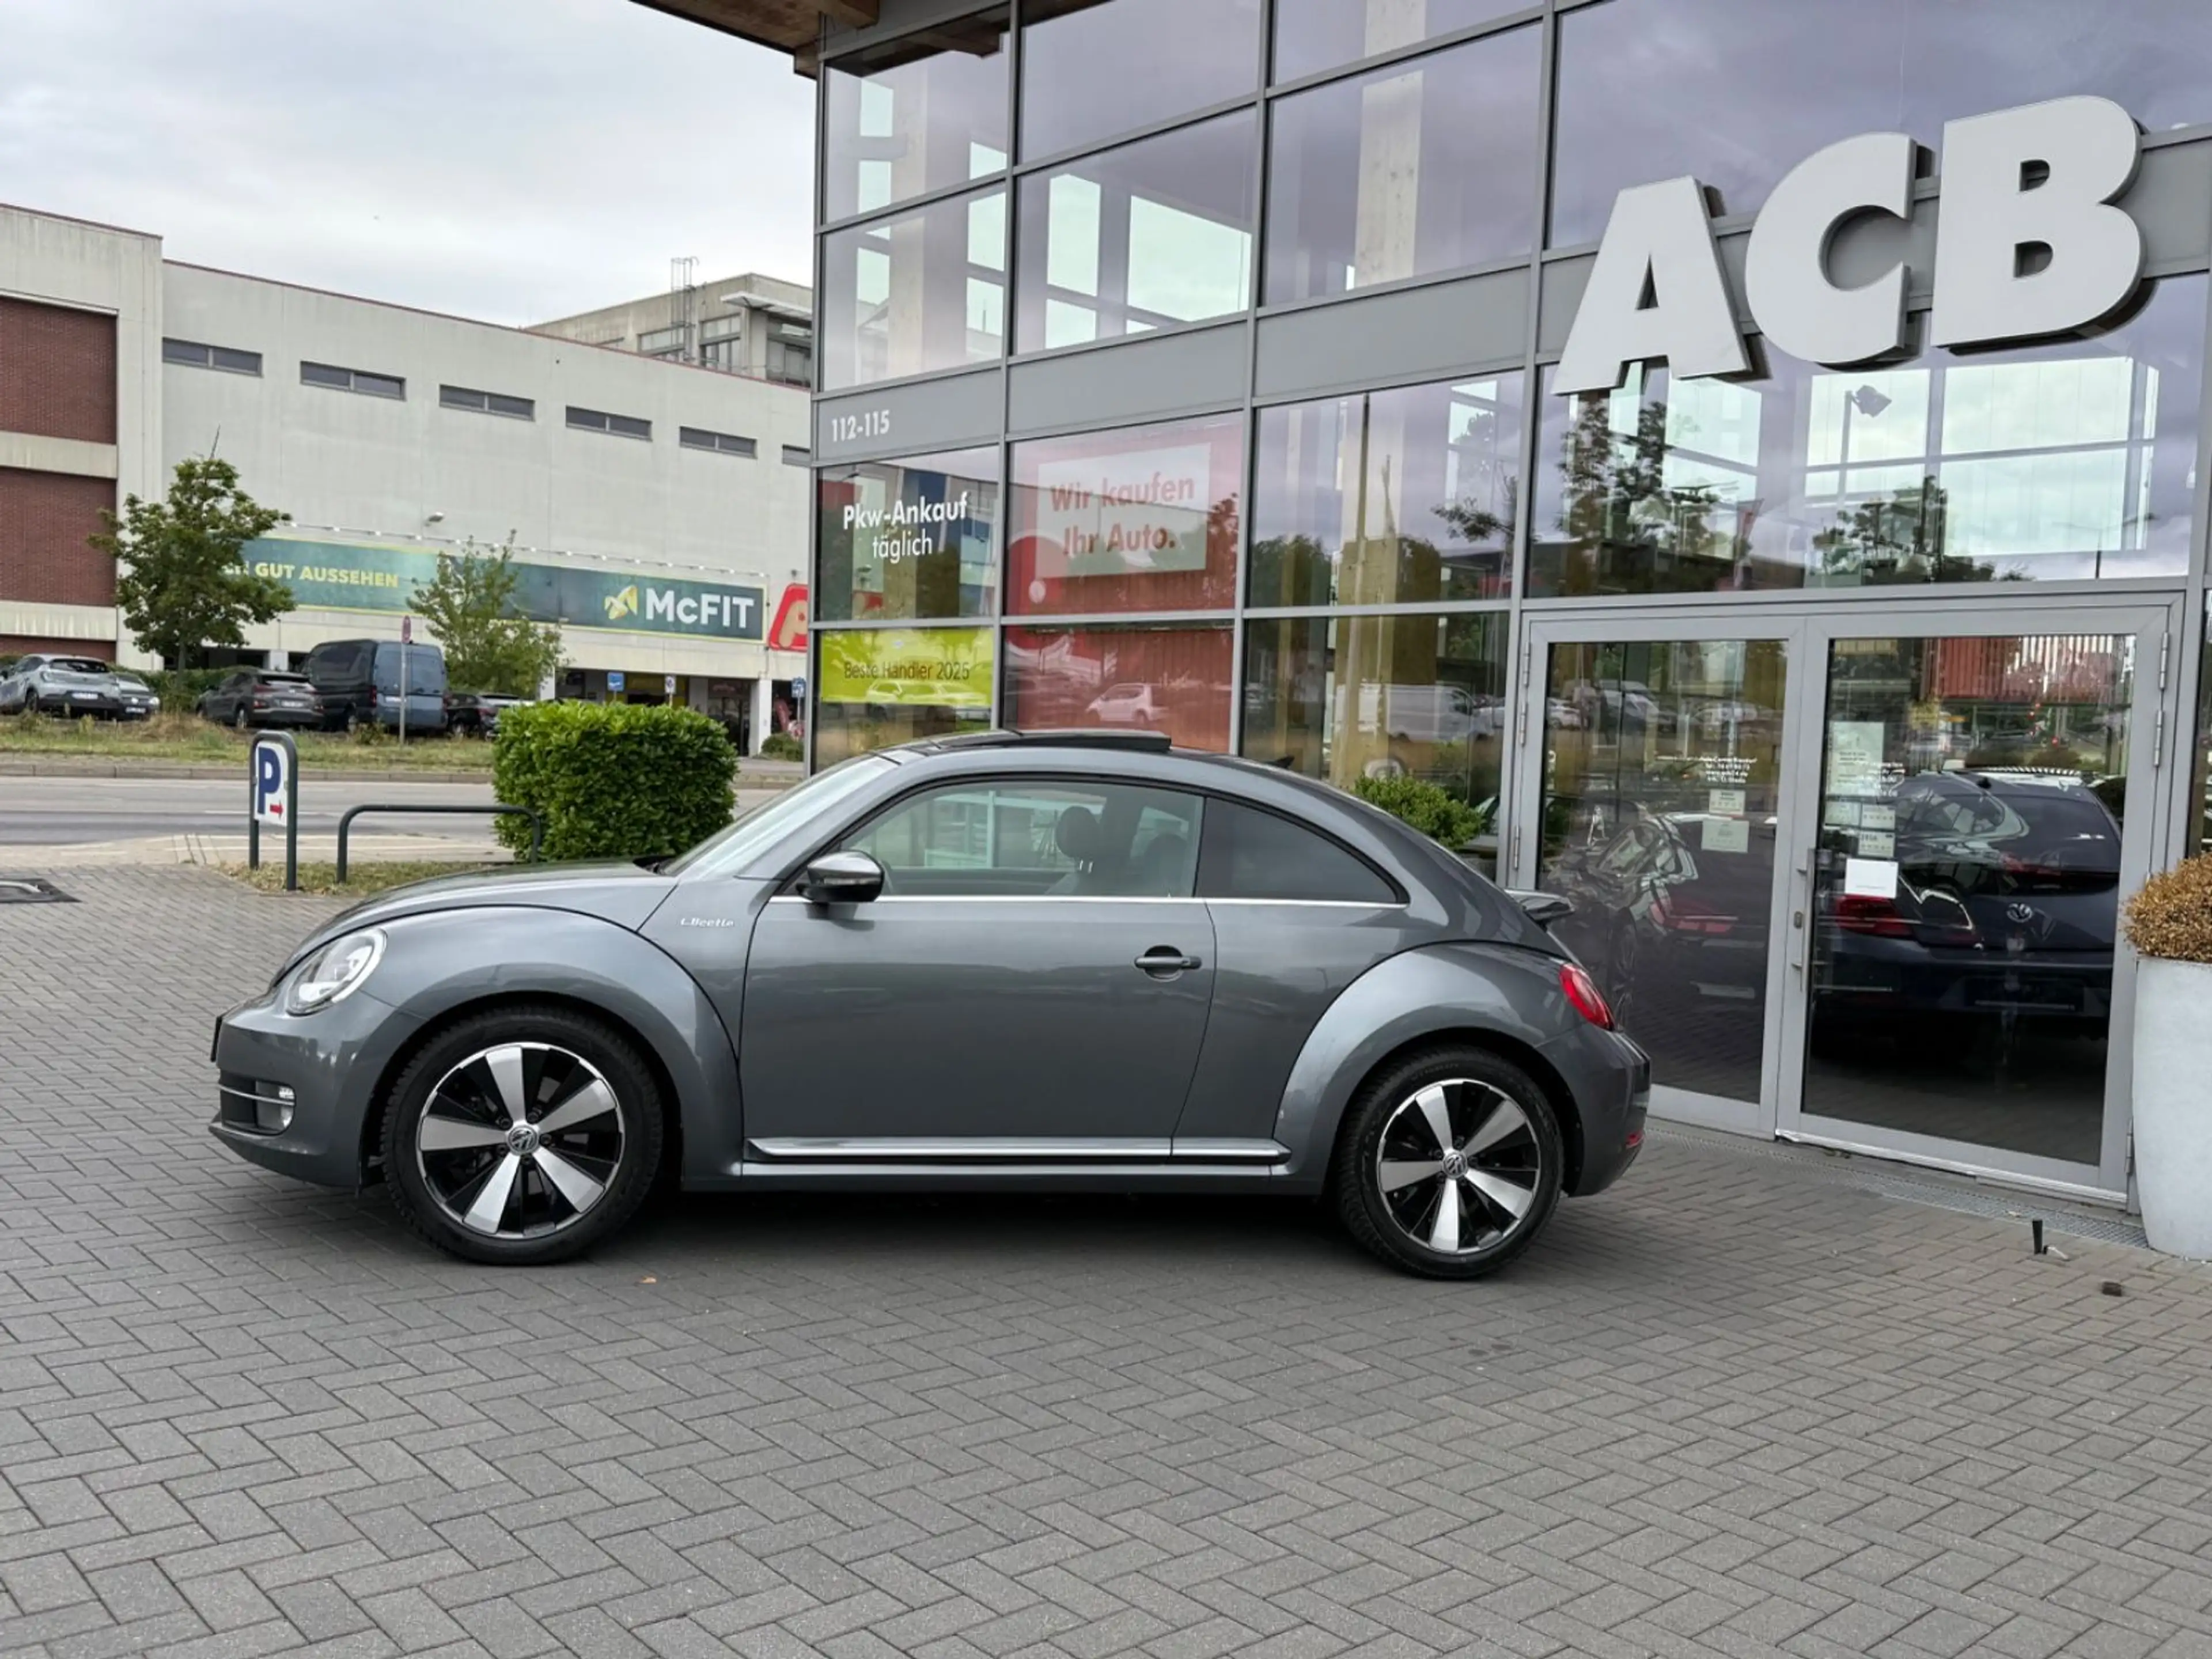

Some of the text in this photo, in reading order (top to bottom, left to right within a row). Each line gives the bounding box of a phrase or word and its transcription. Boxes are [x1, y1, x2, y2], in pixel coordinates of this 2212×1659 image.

[1551, 96, 2145, 396] ACB
[831, 409, 891, 442] 112-115
[1050, 471, 1195, 512] Wir kaufen
[843, 491, 968, 531] Pkw-Ankauf
[872, 528, 933, 564] täglich
[1063, 522, 1176, 555] Ihr Auto.
[255, 562, 296, 579] GUT
[299, 566, 399, 588] AUSSEHEN
[645, 588, 755, 629] McFIT
[844, 662, 879, 679] Beste
[936, 662, 970, 680] 2025
[257, 747, 281, 815] P
